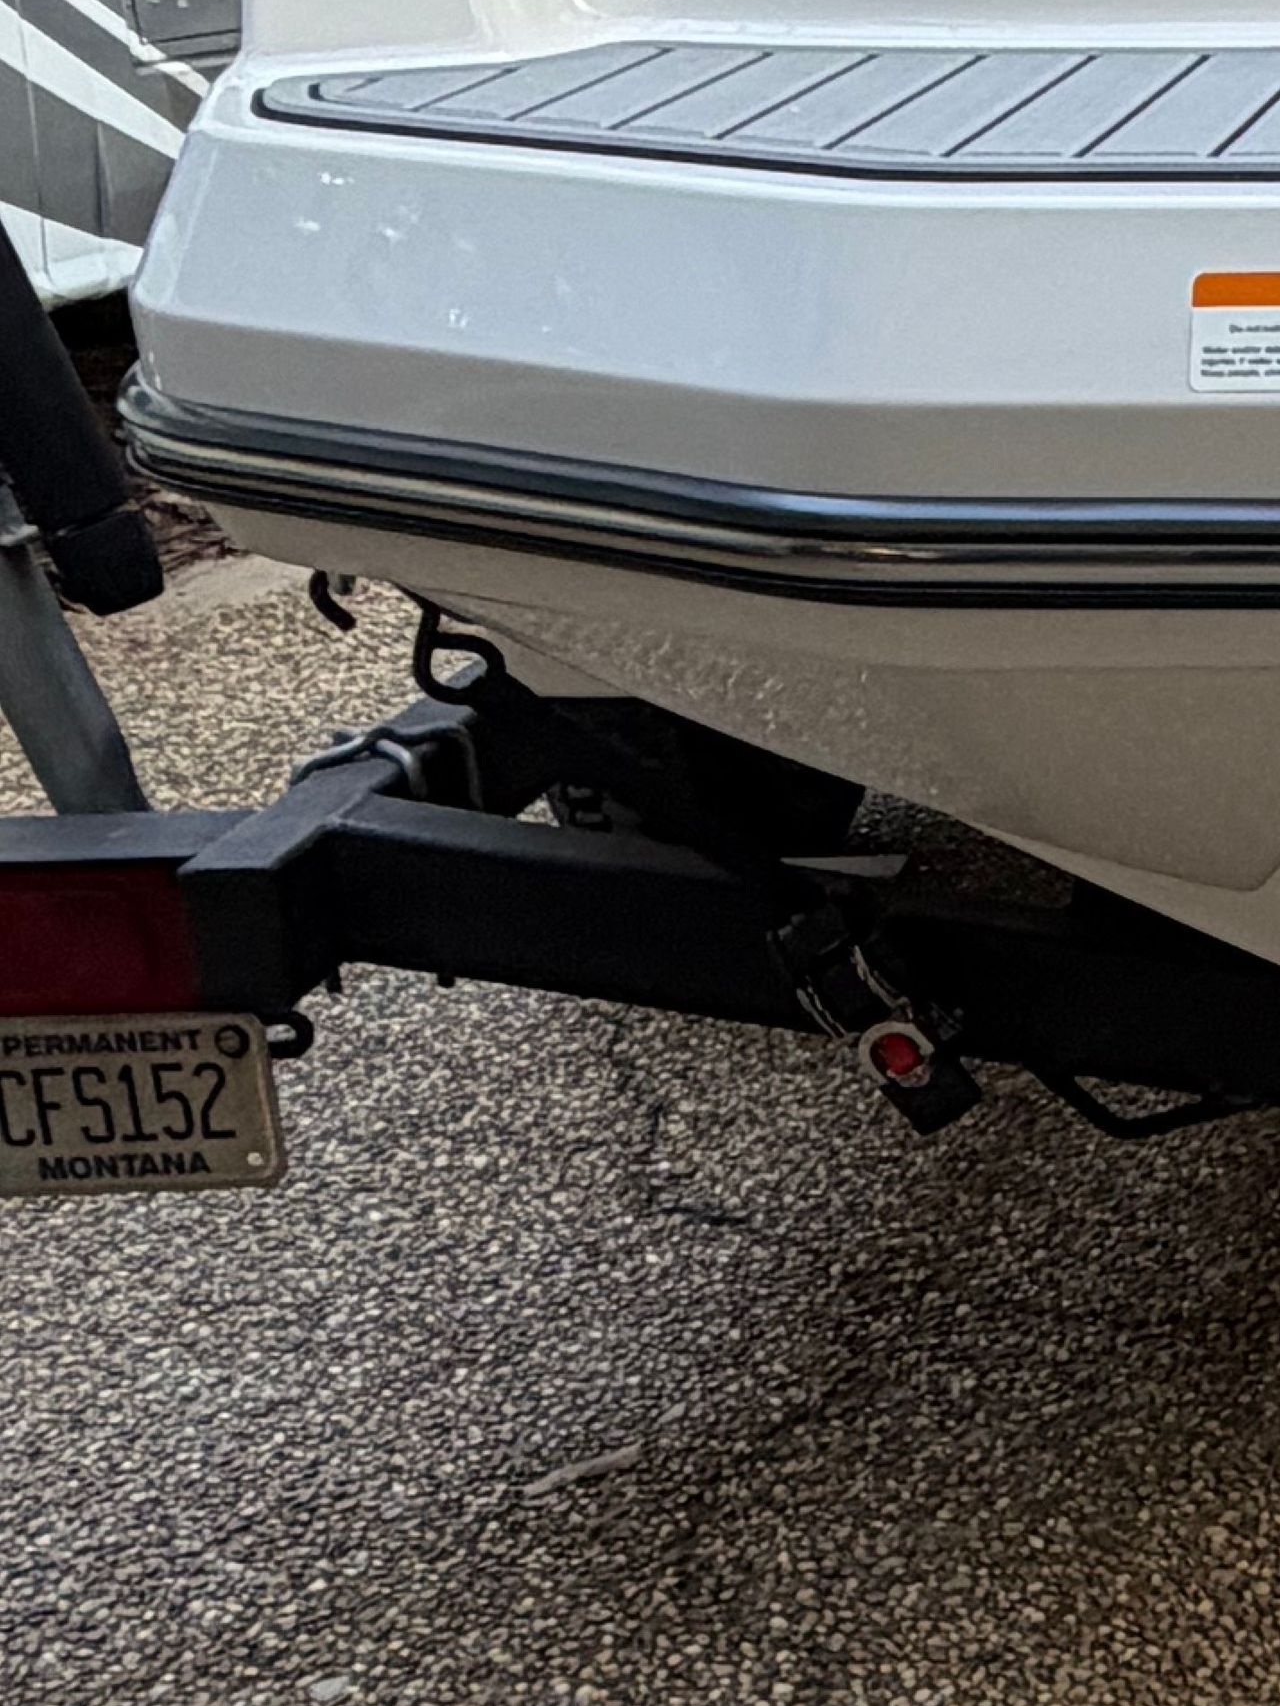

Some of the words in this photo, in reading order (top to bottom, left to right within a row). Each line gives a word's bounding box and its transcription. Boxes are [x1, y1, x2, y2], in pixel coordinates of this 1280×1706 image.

[3, 1029, 201, 1057] PERMANENT
[0, 1062, 236, 1146] CFS152
[38, 1151, 212, 1181] MONTANA
